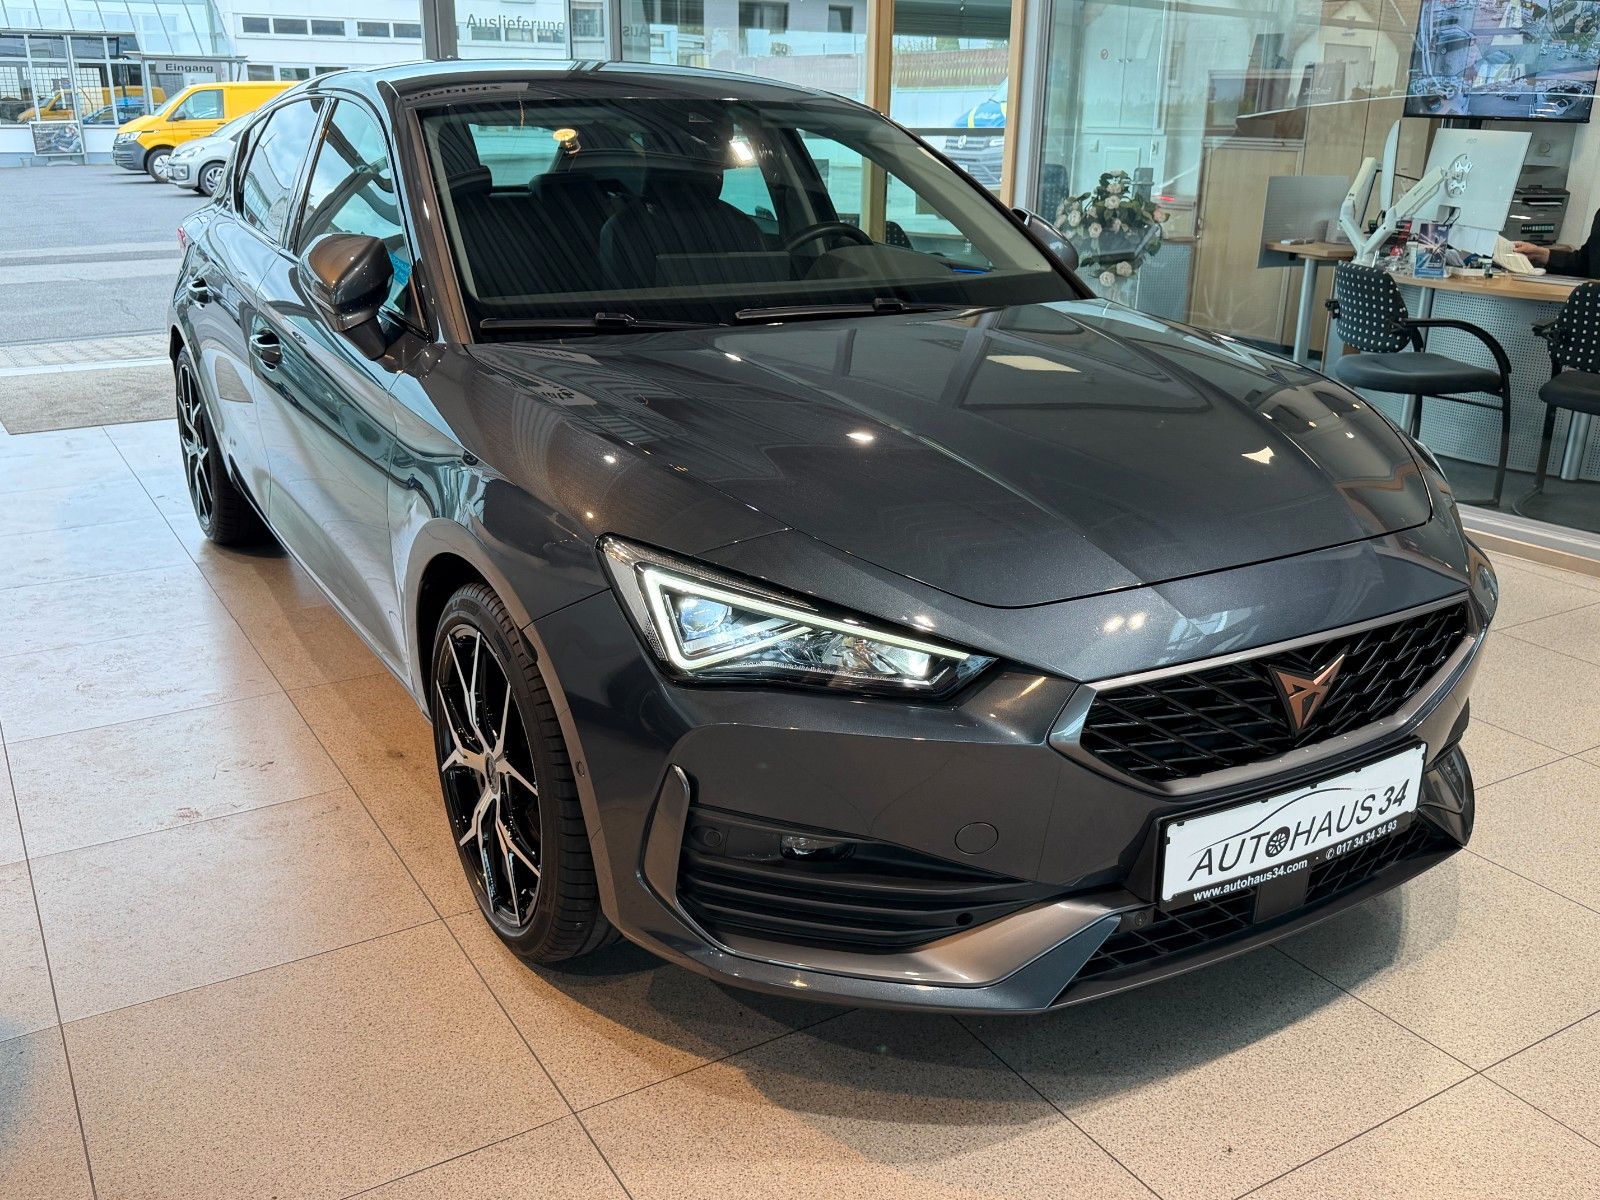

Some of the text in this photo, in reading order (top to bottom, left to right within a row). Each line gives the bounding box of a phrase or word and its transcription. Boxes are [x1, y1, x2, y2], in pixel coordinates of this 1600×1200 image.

[466, 13, 565, 35] Auslieferung
[165, 63, 214, 73] Eingang
[1187, 778, 1410, 882] AUTOHAUS 34
[1336, 819, 1398, 855] 017 34 34 34 93
[1193, 859, 1308, 902] www.autohaus34.com
